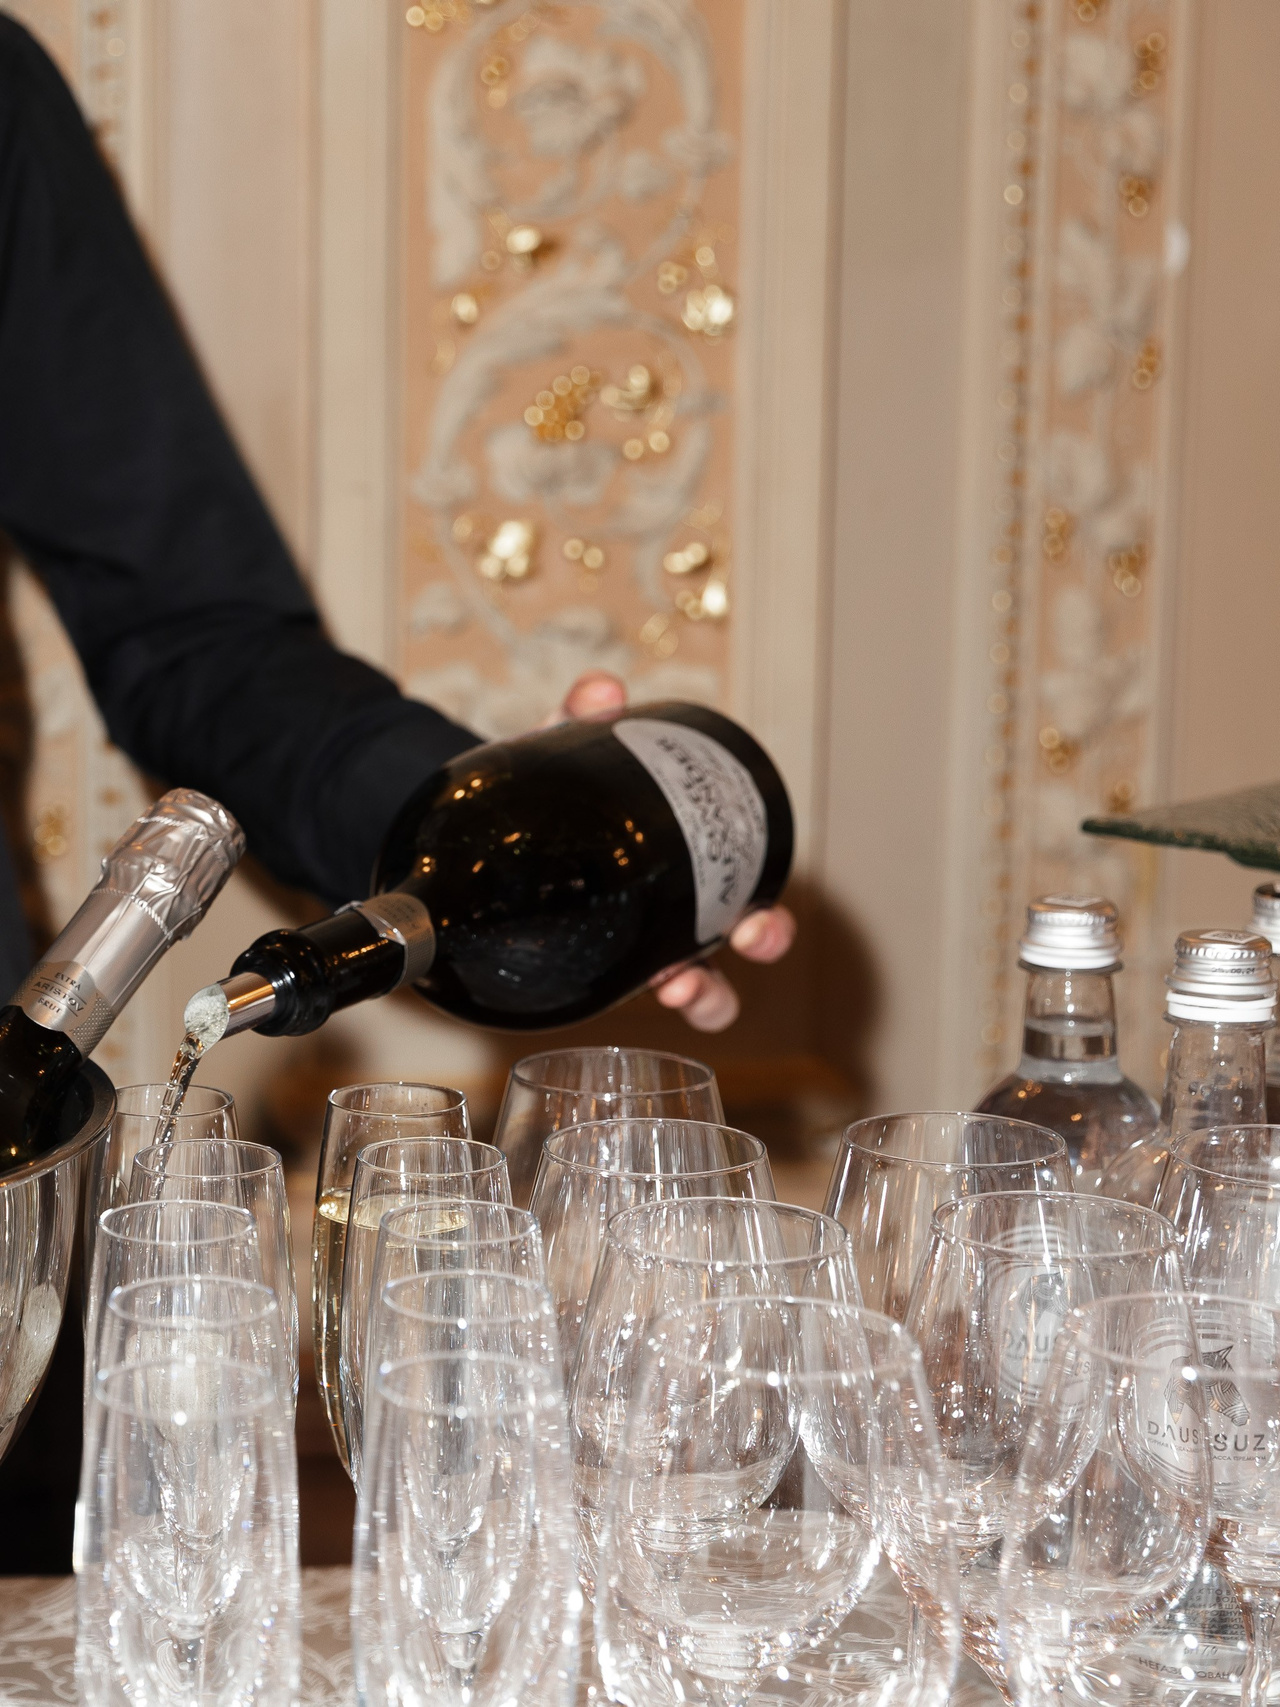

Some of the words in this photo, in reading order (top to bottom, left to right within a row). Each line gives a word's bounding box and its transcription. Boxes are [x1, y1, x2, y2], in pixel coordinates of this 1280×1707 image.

[54, 972, 82, 991] EXTRA
[33, 981, 84, 1012] ARISTOV
[37, 998, 63, 1014] BRUT
